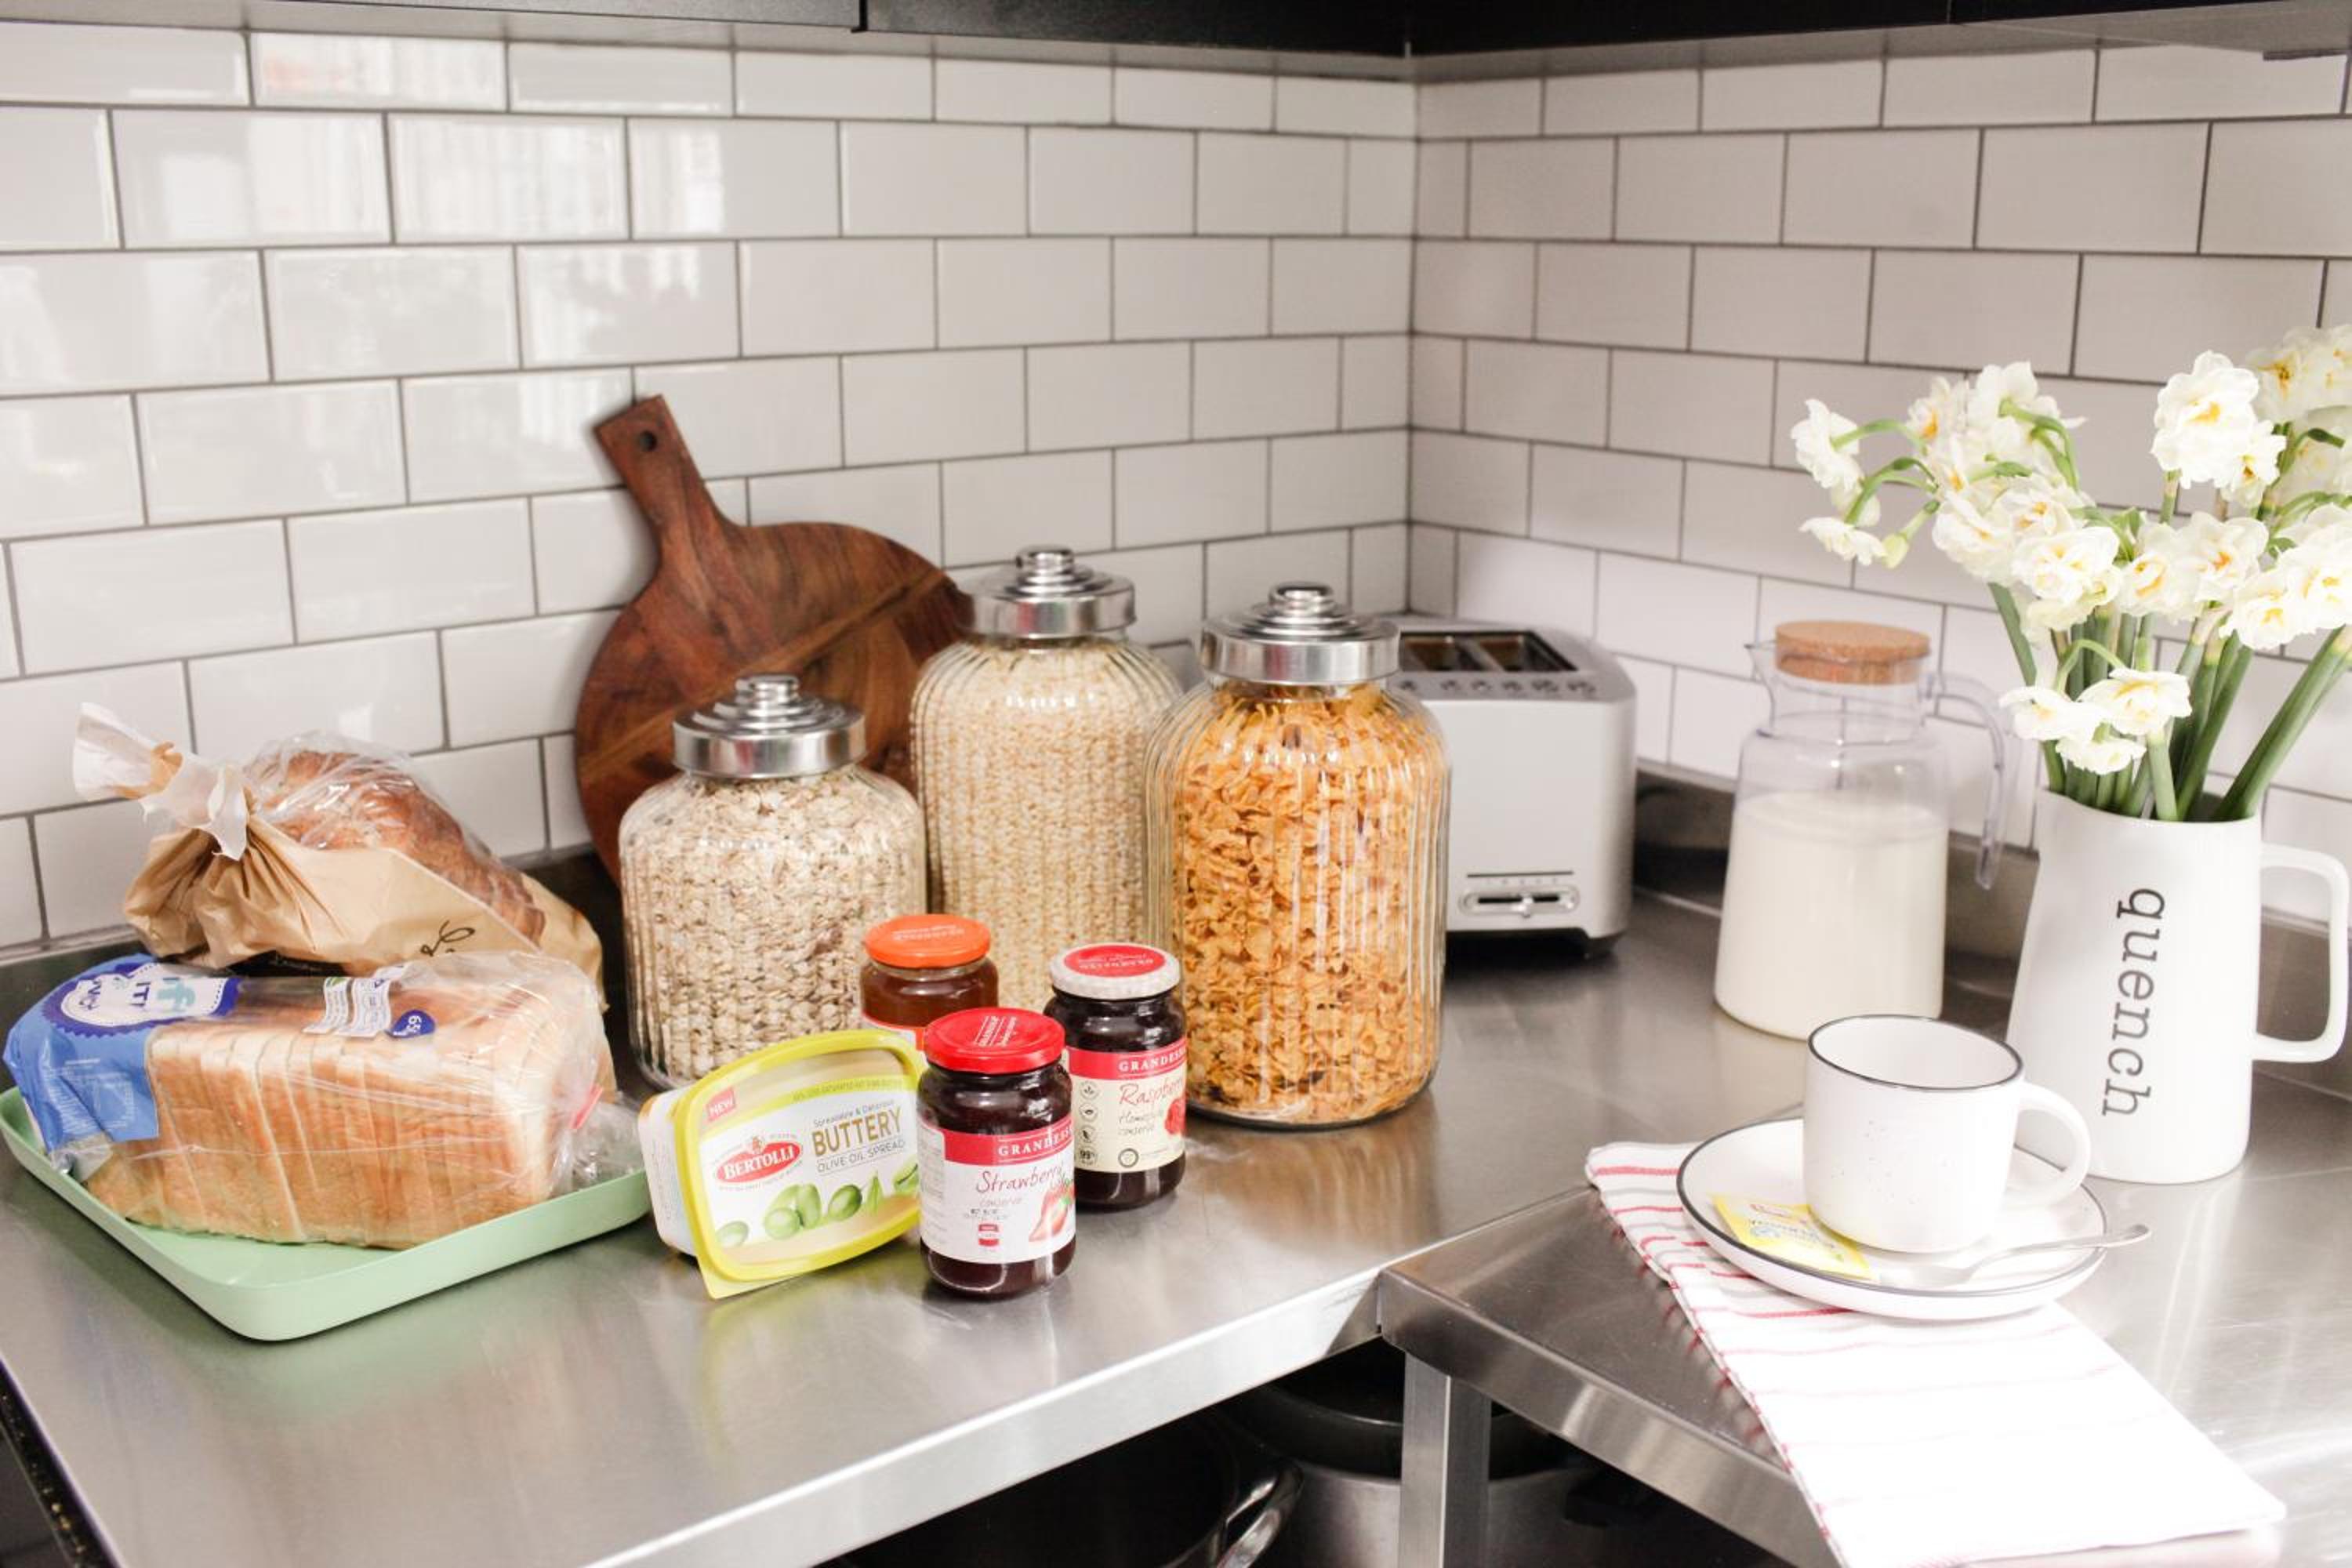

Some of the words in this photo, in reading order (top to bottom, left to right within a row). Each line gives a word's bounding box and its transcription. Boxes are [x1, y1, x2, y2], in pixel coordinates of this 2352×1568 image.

[2102, 888, 2165, 1116] quench
[811, 1106, 901, 1157] BUTTERY
[724, 1145, 794, 1180] BERTOLLI
[817, 1157, 846, 1174] OLIVE
[849, 1152, 865, 1166] OIL
[868, 1139, 906, 1158] SPREAD
